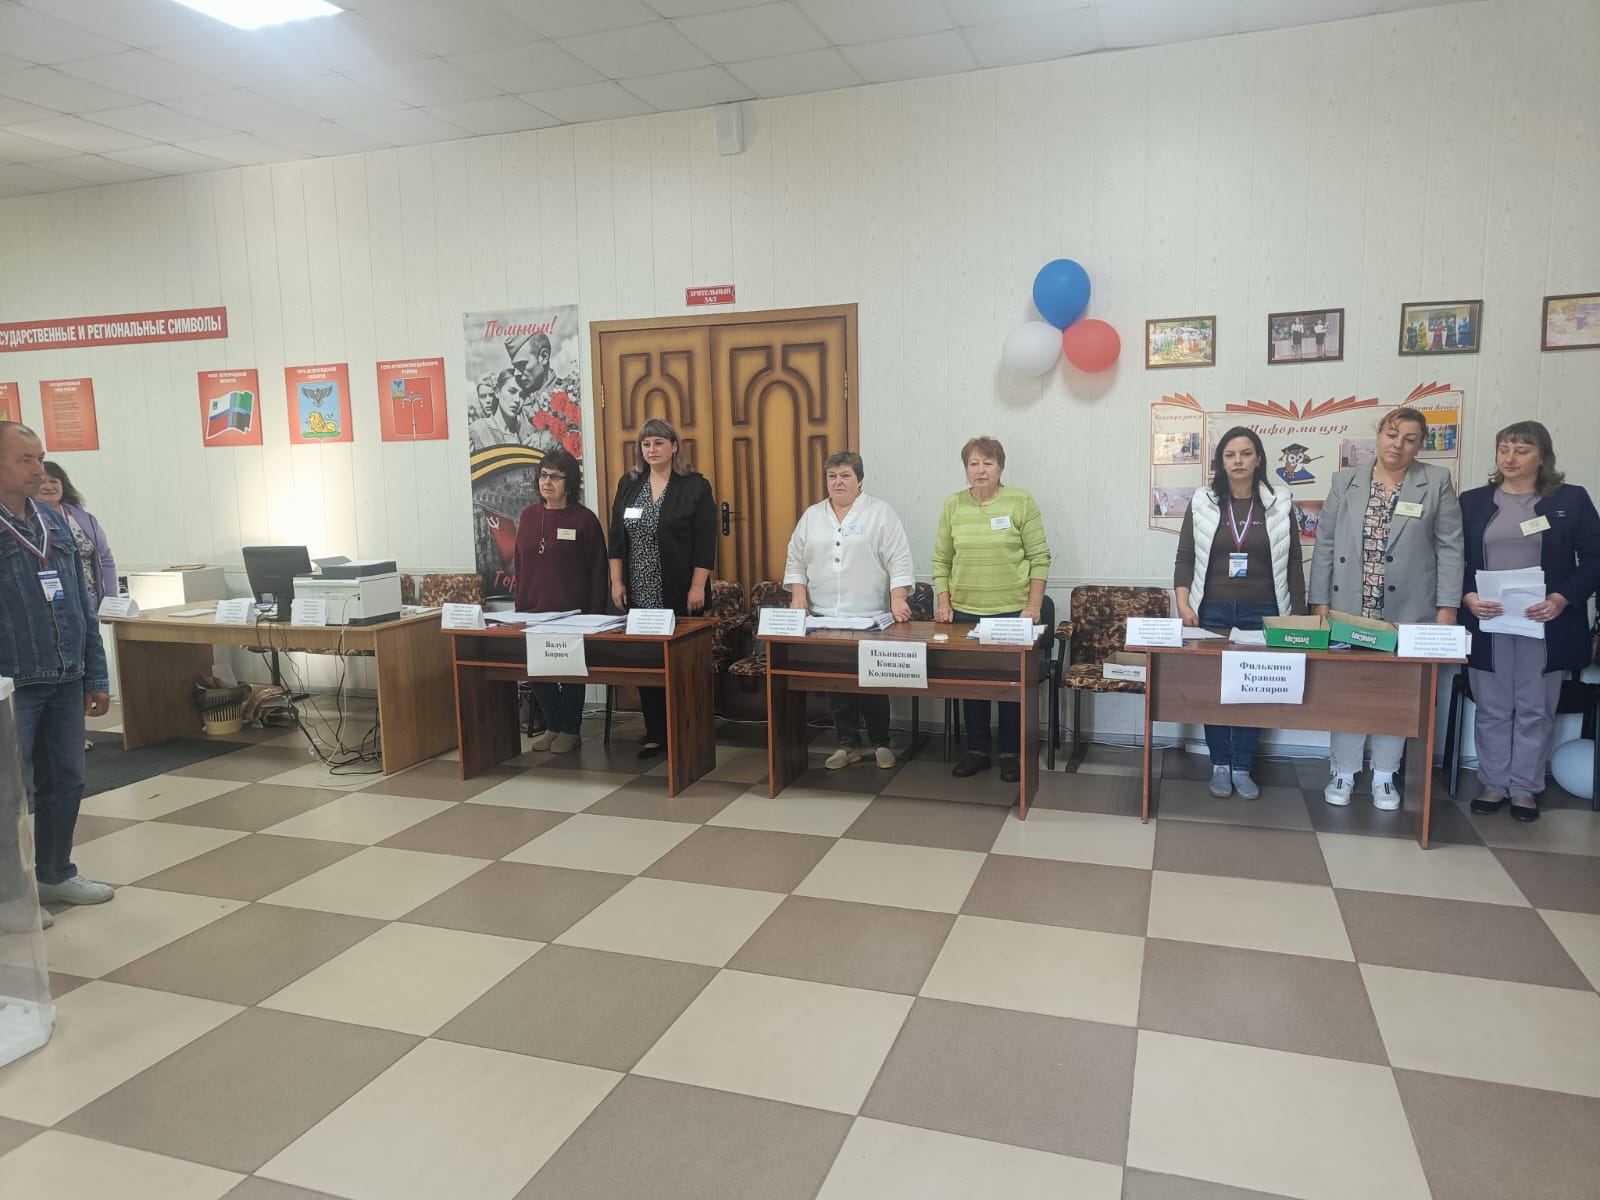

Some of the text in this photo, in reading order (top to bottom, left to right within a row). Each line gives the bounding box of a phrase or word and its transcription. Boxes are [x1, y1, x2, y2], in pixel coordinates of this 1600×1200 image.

[690, 287, 731, 297] ЗРИТЕЛЬНЫЙ
[78, 325, 86, 340] И
[88, 319, 166, 340] РЕГИОНАЛЬНЫЕ
[168, 315, 222, 334] СИМВОЛЫ
[485, 315, 557, 338] Помним!
[1249, 423, 1348, 436] Информация
[545, 640, 567, 650] Валуй
[871, 649, 917, 659] Ильинский
[877, 660, 911, 669] Ковалёв
[1240, 661, 1292, 671] Филькино
[868, 669, 921, 679] Коломыцево
[1244, 672, 1287, 683] Кравцов
[1241, 684, 1289, 695] Котляров
